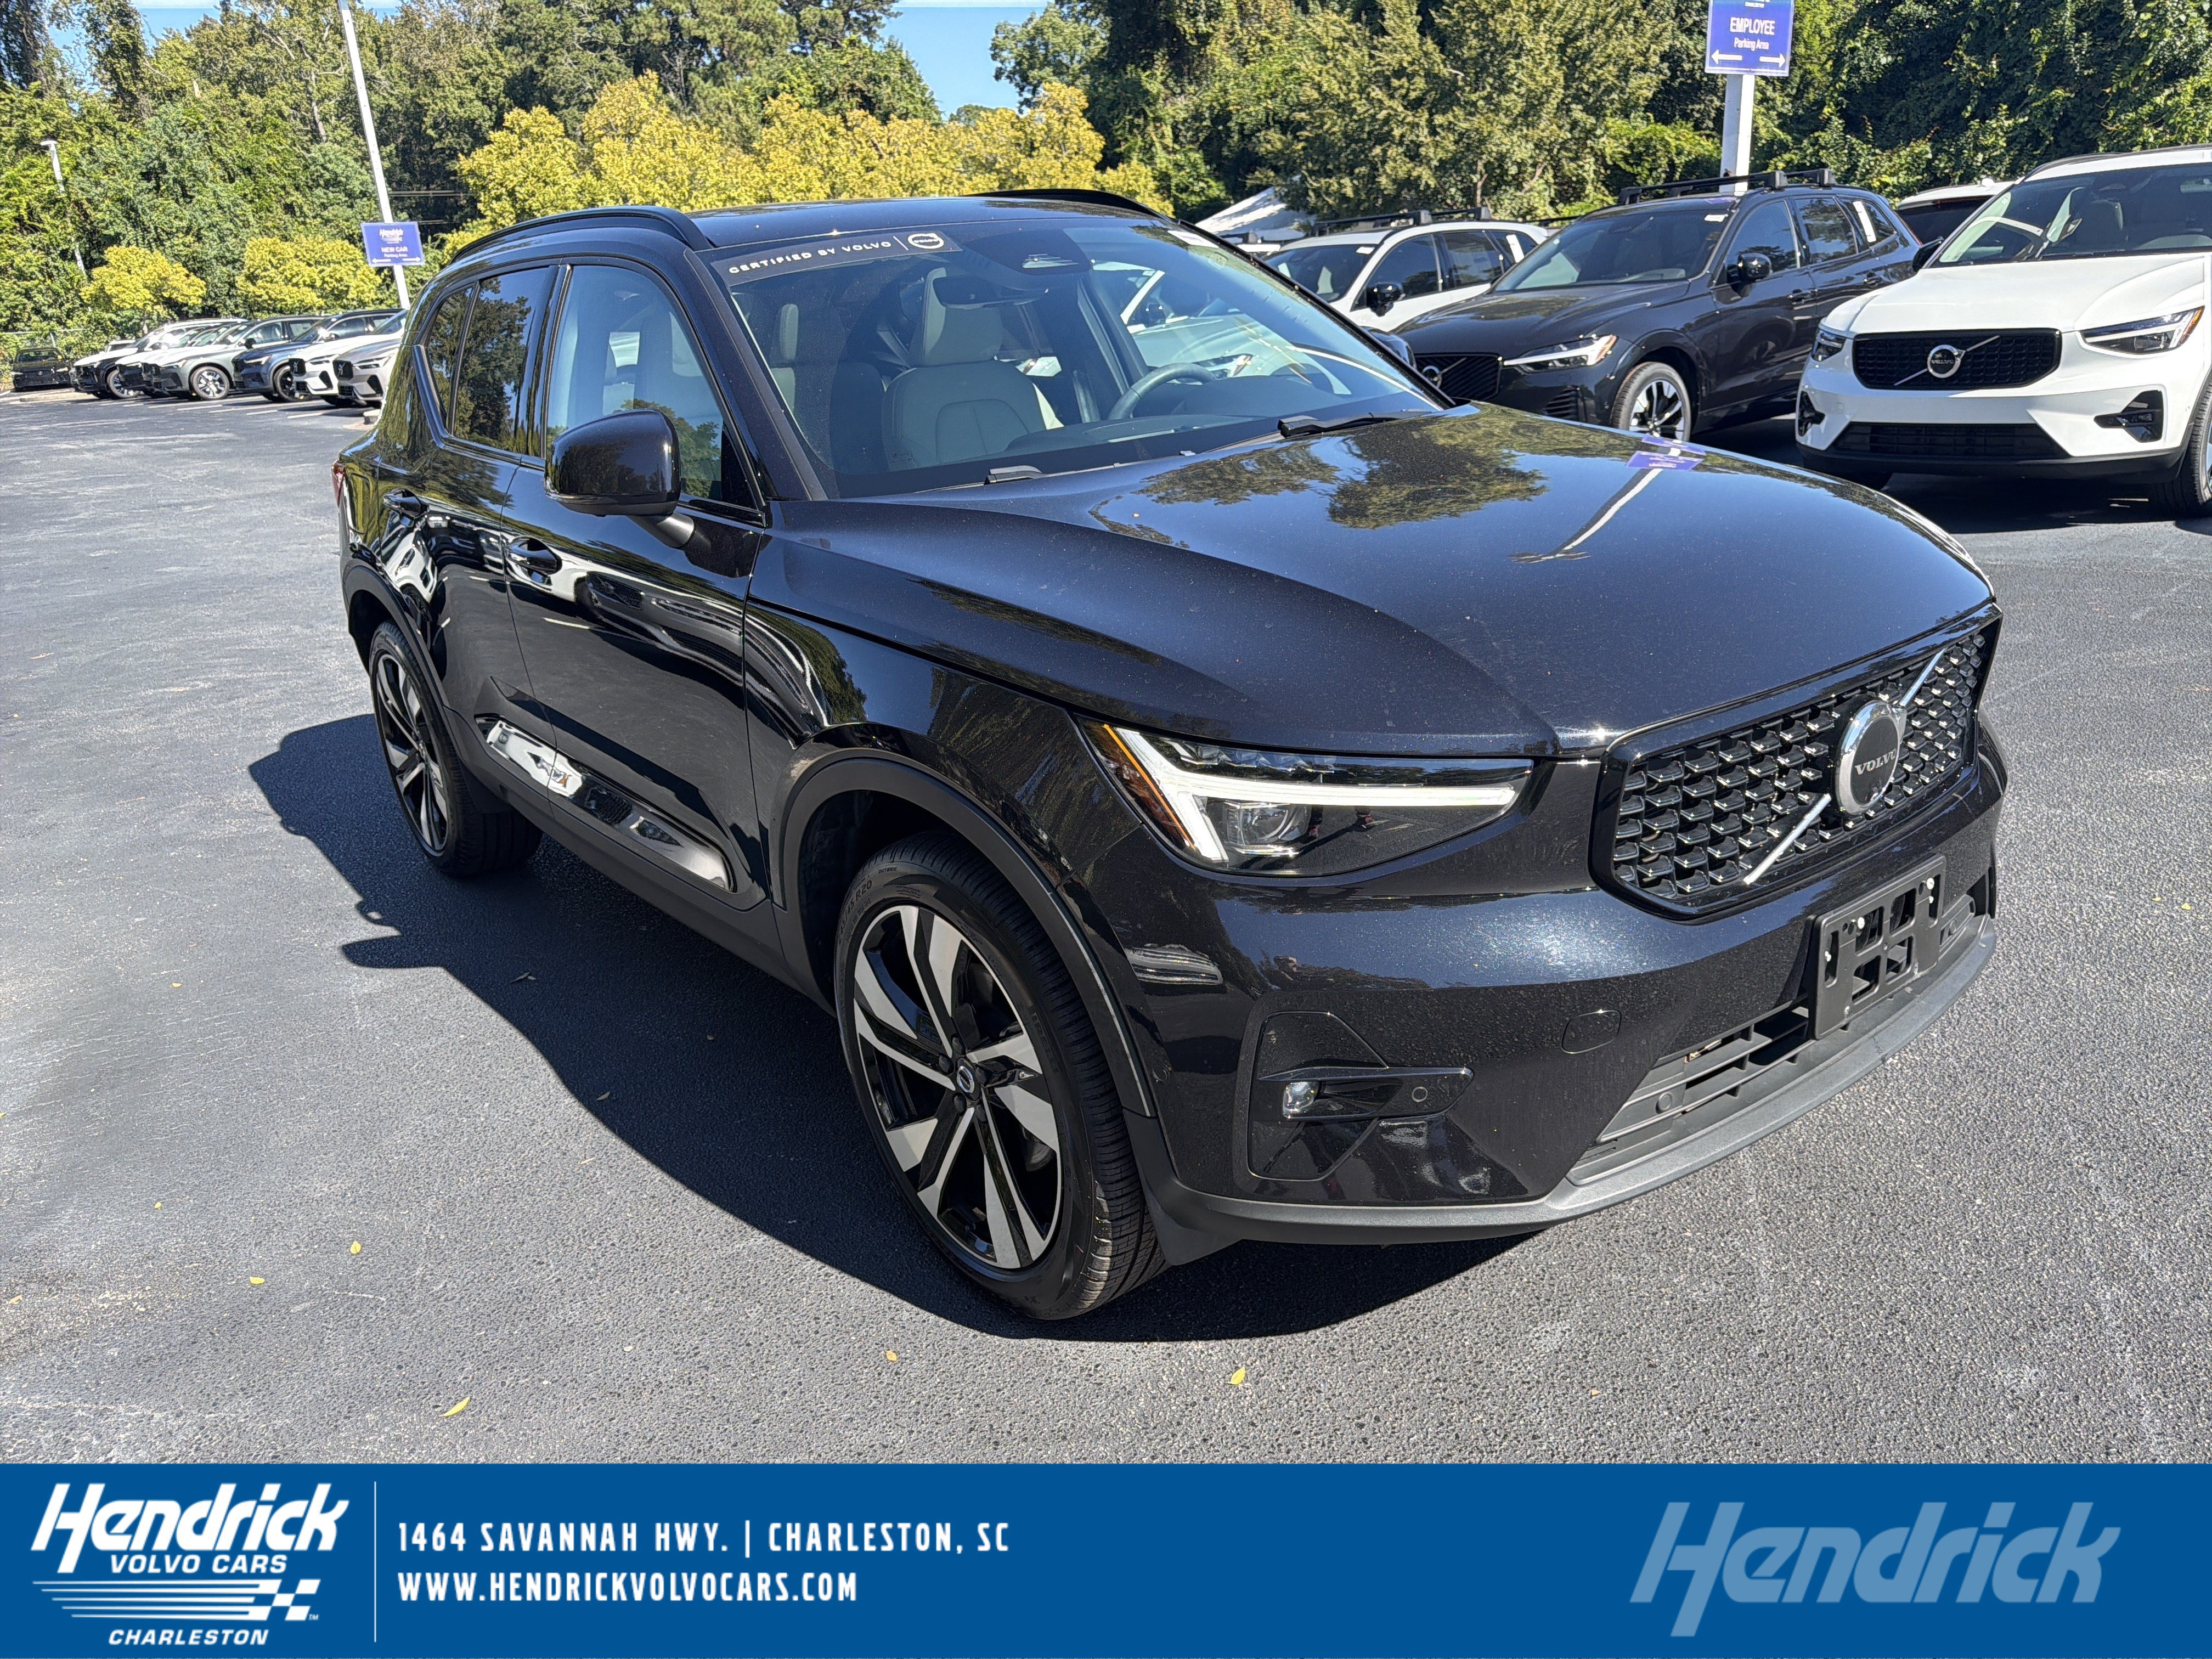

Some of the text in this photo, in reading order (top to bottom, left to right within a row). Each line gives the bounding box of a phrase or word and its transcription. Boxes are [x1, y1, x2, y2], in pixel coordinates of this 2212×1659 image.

[1730, 17, 1775, 35] EMPLOYEE
[1734, 37, 1769, 51] Parking Area
[729, 252, 812, 274] CERTIFIED
[842, 241, 891, 252] VOLVO
[1854, 748, 1897, 775] VOLVO
